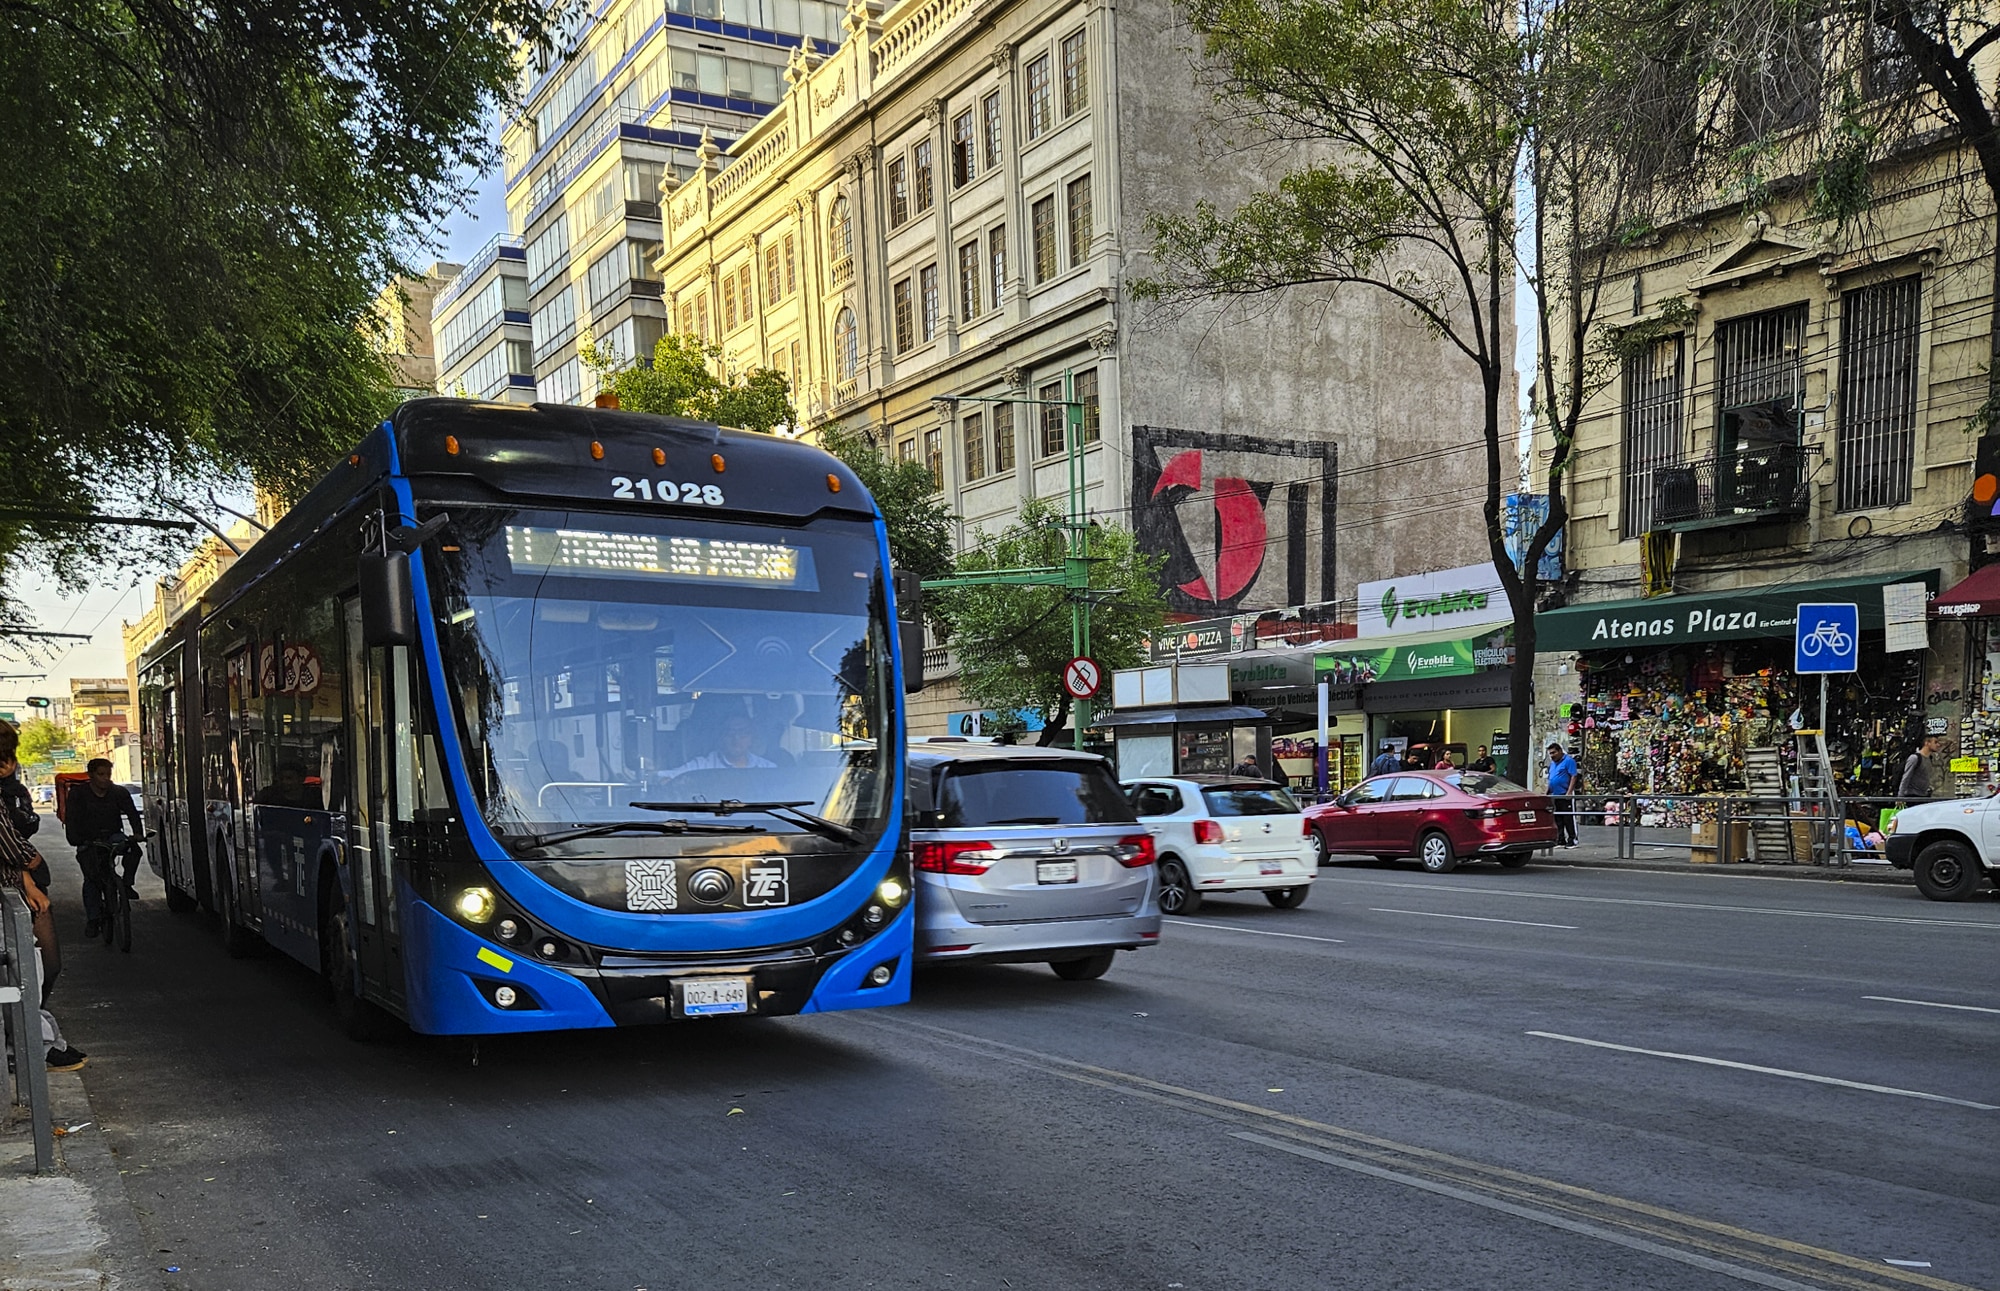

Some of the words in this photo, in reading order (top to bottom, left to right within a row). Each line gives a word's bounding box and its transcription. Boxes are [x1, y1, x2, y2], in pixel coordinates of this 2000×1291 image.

[611, 476, 725, 506] 21028
[1402, 589, 1488, 618] Evobike
[1591, 618, 1675, 641] Atenas
[1687, 609, 1757, 633] Plaza
[1198, 630, 1223, 647] PIZZA
[1417, 654, 1454, 666] Evobike
[1230, 663, 1287, 682] Evobike
